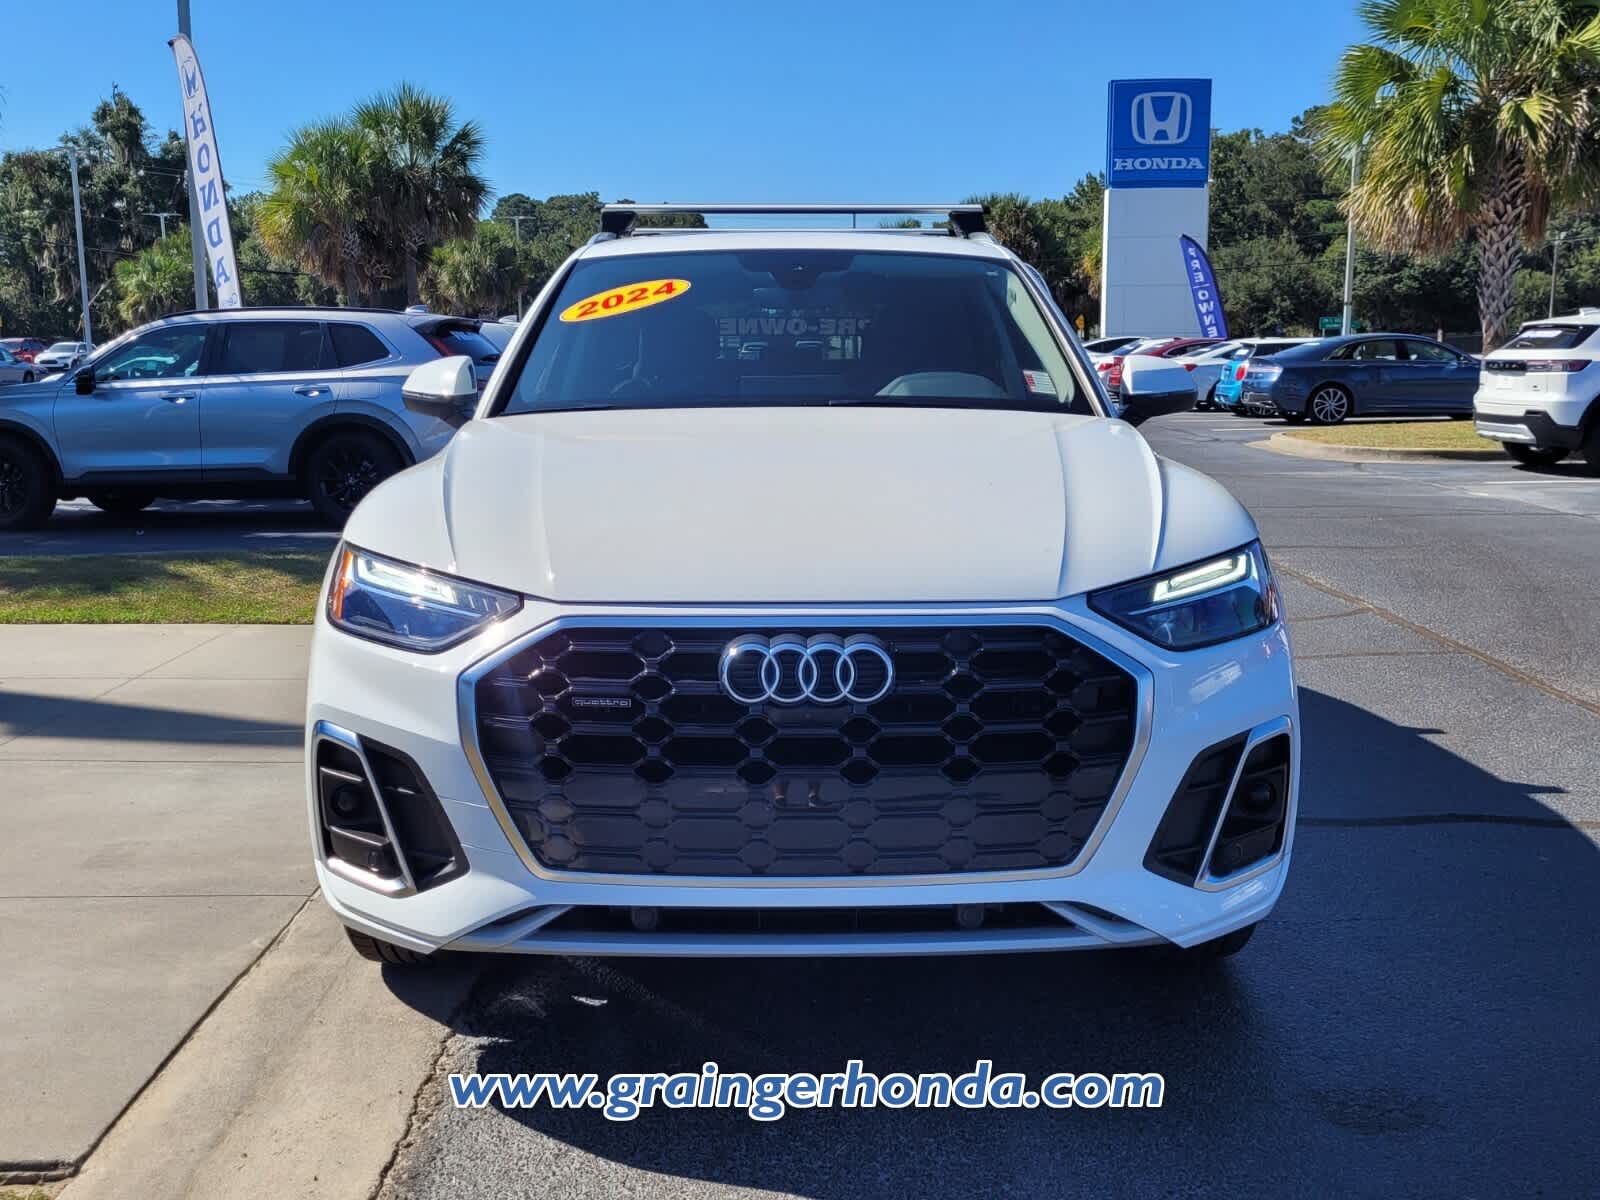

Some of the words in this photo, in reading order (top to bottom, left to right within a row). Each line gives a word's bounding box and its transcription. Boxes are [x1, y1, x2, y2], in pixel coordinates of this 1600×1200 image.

[1113, 157, 1205, 171] HONDA
[576, 280, 677, 319] 2024
[574, 698, 629, 707] quattro
